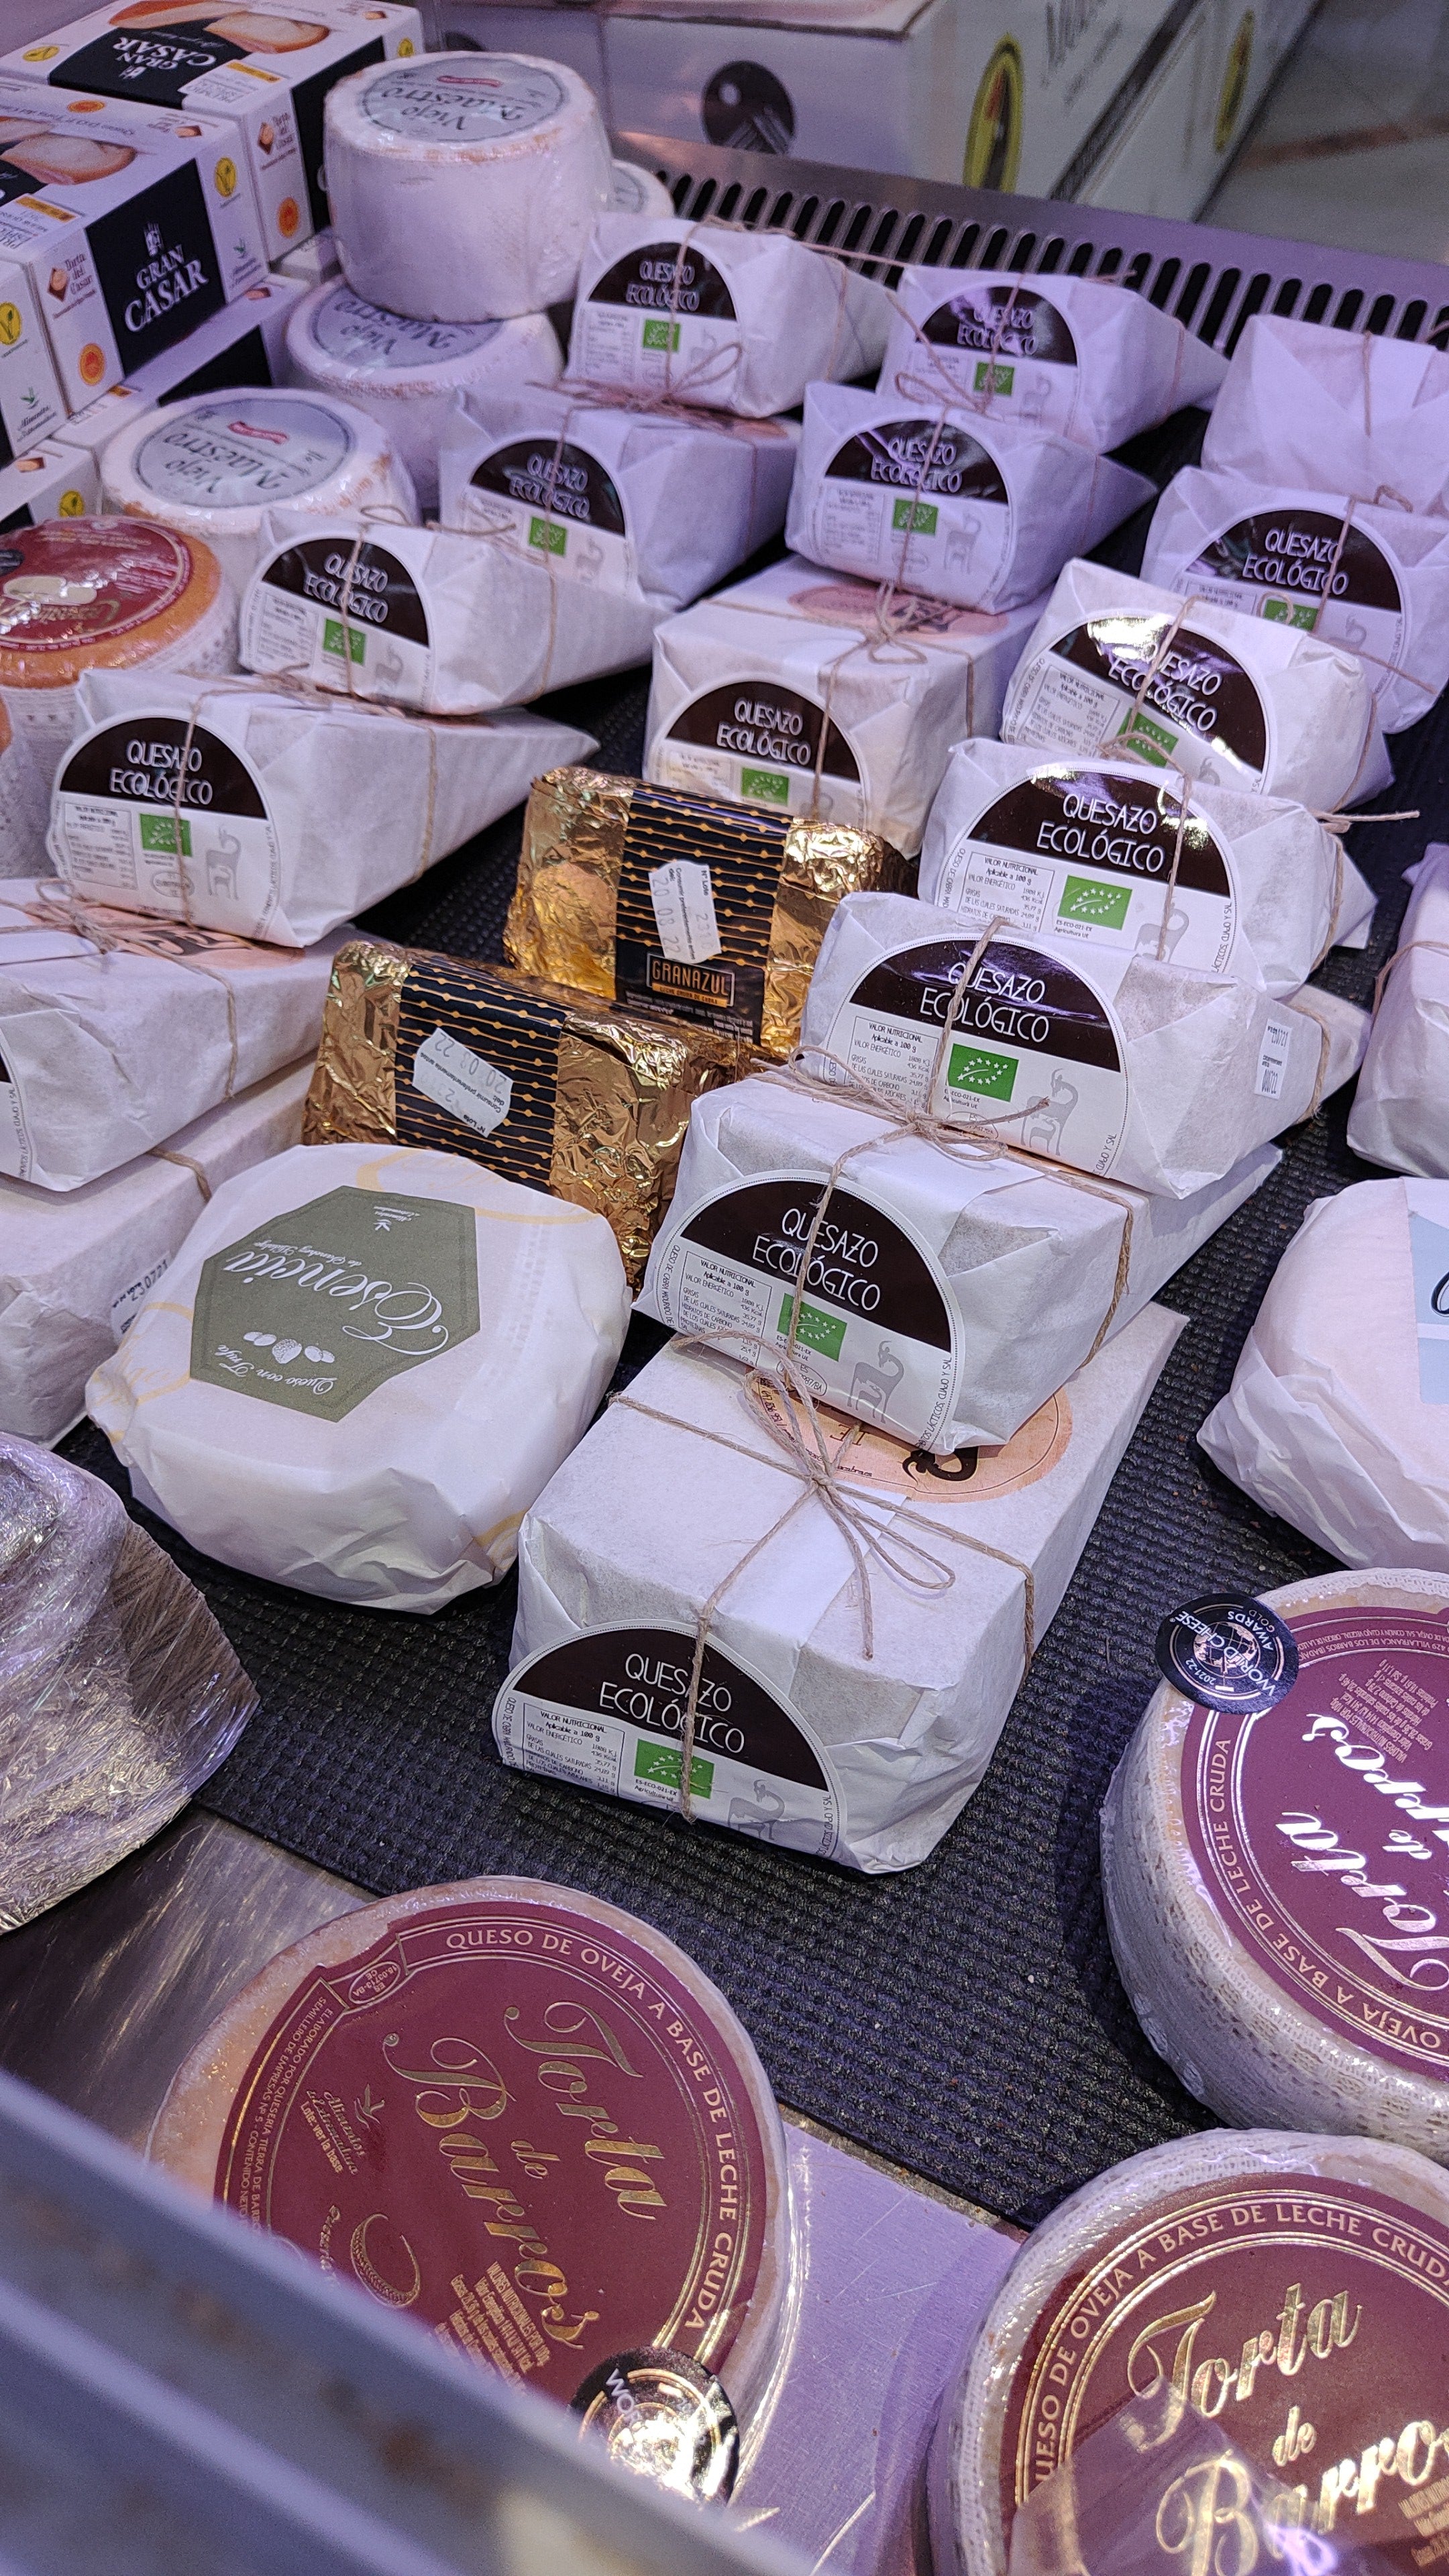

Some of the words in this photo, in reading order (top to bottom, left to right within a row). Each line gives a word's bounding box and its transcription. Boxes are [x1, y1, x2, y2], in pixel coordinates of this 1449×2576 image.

[113, 38, 216, 66] CASAR
[115, 53, 178, 70] GRAN
[136, 245, 184, 289] GRAN
[125, 259, 209, 331] CASAR
[164, 431, 287, 490] Maestro
[1265, 527, 1340, 563] QUESAZO
[735, 699, 803, 736] QUESAZO
[716, 722, 811, 765] ECOLÓGICO
[1063, 793, 1157, 836] QUESAZO
[1036, 820, 1165, 873] ECOLÓGICO
[651, 877, 670, 897] 20
[662, 935, 680, 955] 22
[652, 960, 729, 996] GRANAZUL
[431, 1032, 458, 1058] 22
[854, 1039, 869, 1050] VALOR
[869, 1022, 885, 1034] VALOR
[887, 1028, 922, 1043] NUTRICIONAL
[685, 1273, 701, 1285] VALOR
[702, 1279, 734, 1297] ENERGÉTICO
[700, 1259, 718, 1272] VALOR
[719, 1268, 756, 1288] NUTRICIONAL
[223, 1252, 449, 1355] Esencia
[215, 1344, 255, 1377] Trufa
[258, 1370, 282, 1383] con
[943, 1357, 952, 1370] SAL
[286, 1375, 337, 1395] Queso
[1228, 1611, 1273, 1651] AWARDS
[1248, 1609, 1275, 1633] GOLD
[1381, 1638, 1430, 1649] VILLAFRANCA
[625, 1654, 732, 1711] QUESZO
[1185, 1658, 1217, 1686] 2021-22
[1224, 1646, 1276, 1696] WORLD
[541, 1711, 561, 1723] VALOR
[562, 1717, 606, 1733] NUTRICIONAL
[1210, 1739, 1231, 1813] CRUDA
[1213, 1821, 1249, 1895] LECHE
[1382, 1829, 1432, 1860] de
[1246, 1904, 1275, 1932] DE
[446, 1929, 533, 1949] QUESO
[543, 1933, 574, 1955] DE
[581, 1947, 645, 2000] OVEJA
[1275, 1934, 1328, 1988] BASE
[647, 2002, 666, 2021] A
[1328, 1986, 1354, 2007] A
[290, 1997, 326, 2045] SEMILLERO
[292, 2008, 333, 2064] ELABORADO
[1362, 2002, 1440, 2049] OVEJA
[666, 2019, 710, 2082] BASE
[262, 2055, 289, 2101] EMPRESAS
[283, 2063, 299, 2084] POR
[504, 2001, 667, 2220] Torta
[703, 2086, 727, 2123] DE
[258, 2139, 269, 2173] TIERRA
[300, 2102, 316, 2127] Lote:
[313, 2125, 325, 2141] ver
[326, 2149, 343, 2174] base
[241, 2130, 259, 2189] CONTENIDO
[511, 2140, 560, 2180] de
[716, 2133, 738, 2220] LECHE
[252, 2176, 262, 2192] DE
[382, 2033, 600, 2348] Barros
[685, 2232, 733, 2330] CRUDA
[1035, 2394, 1063, 2481] UESO
[1049, 2348, 1076, 2386] DE
[1071, 2267, 1134, 2341] OVEJA
[1136, 2249, 1157, 2271] A
[1159, 2214, 1224, 2253] BASE
[1233, 2204, 1267, 2226] DE
[1275, 2203, 1362, 2237] LECHE
[1127, 2282, 1363, 2452] Torta
[1273, 2406, 1317, 2467] de
